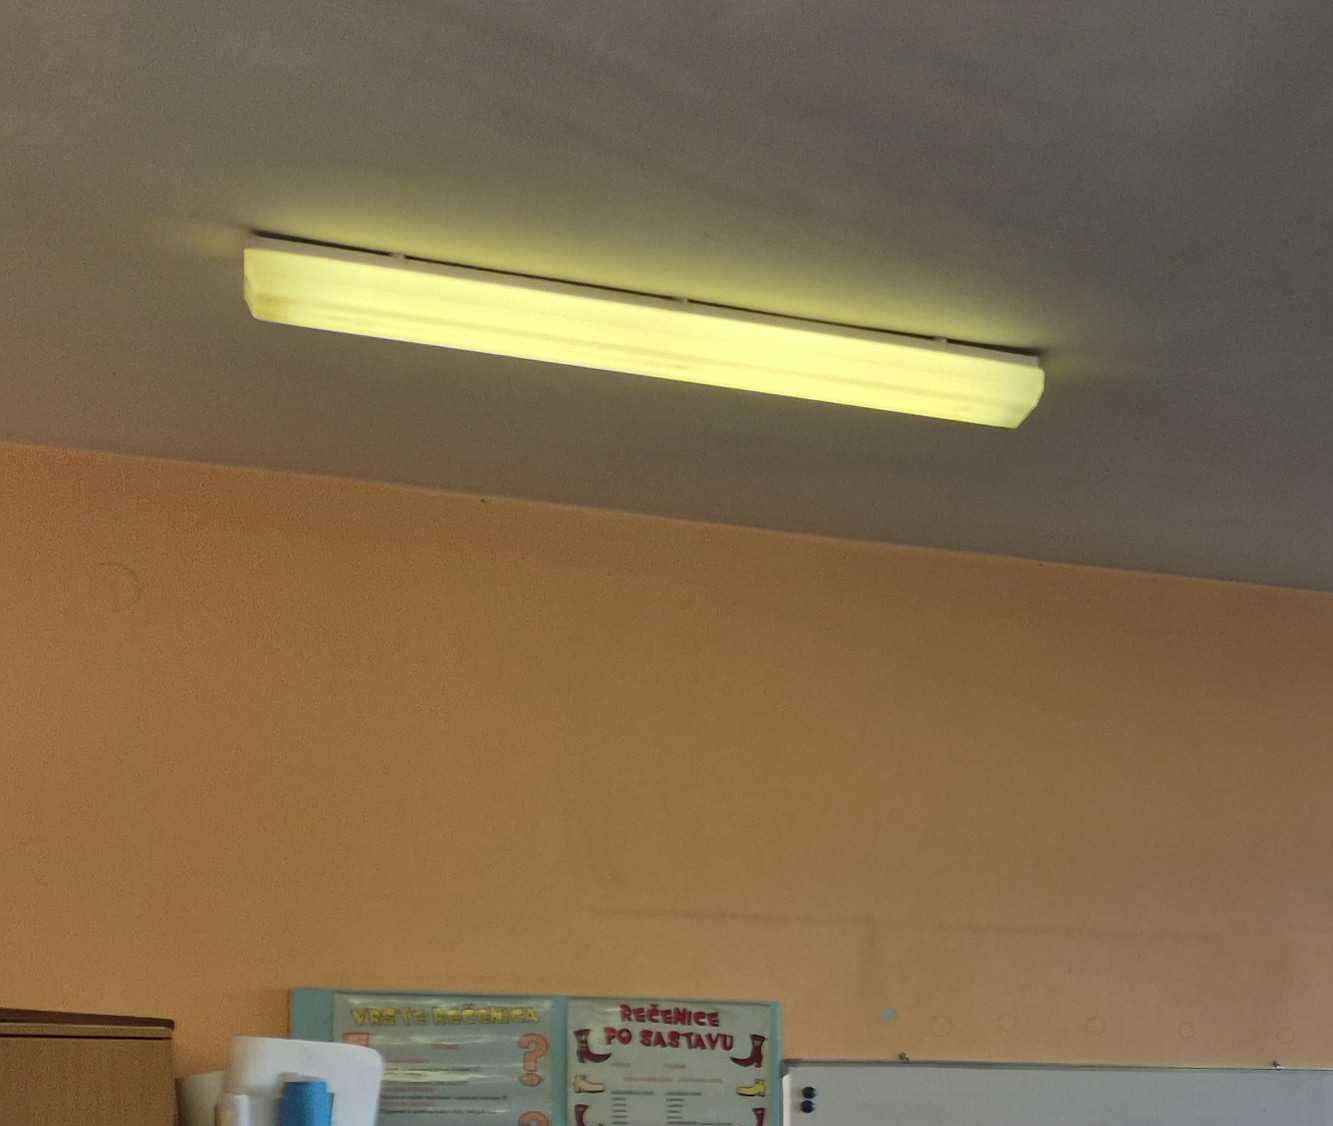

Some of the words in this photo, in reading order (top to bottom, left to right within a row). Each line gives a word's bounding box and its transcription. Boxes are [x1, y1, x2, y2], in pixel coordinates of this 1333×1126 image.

[620, 1004, 720, 1027] REČENICE
[604, 1027, 633, 1046] PO
[640, 1030, 734, 1051] SASTAVU
